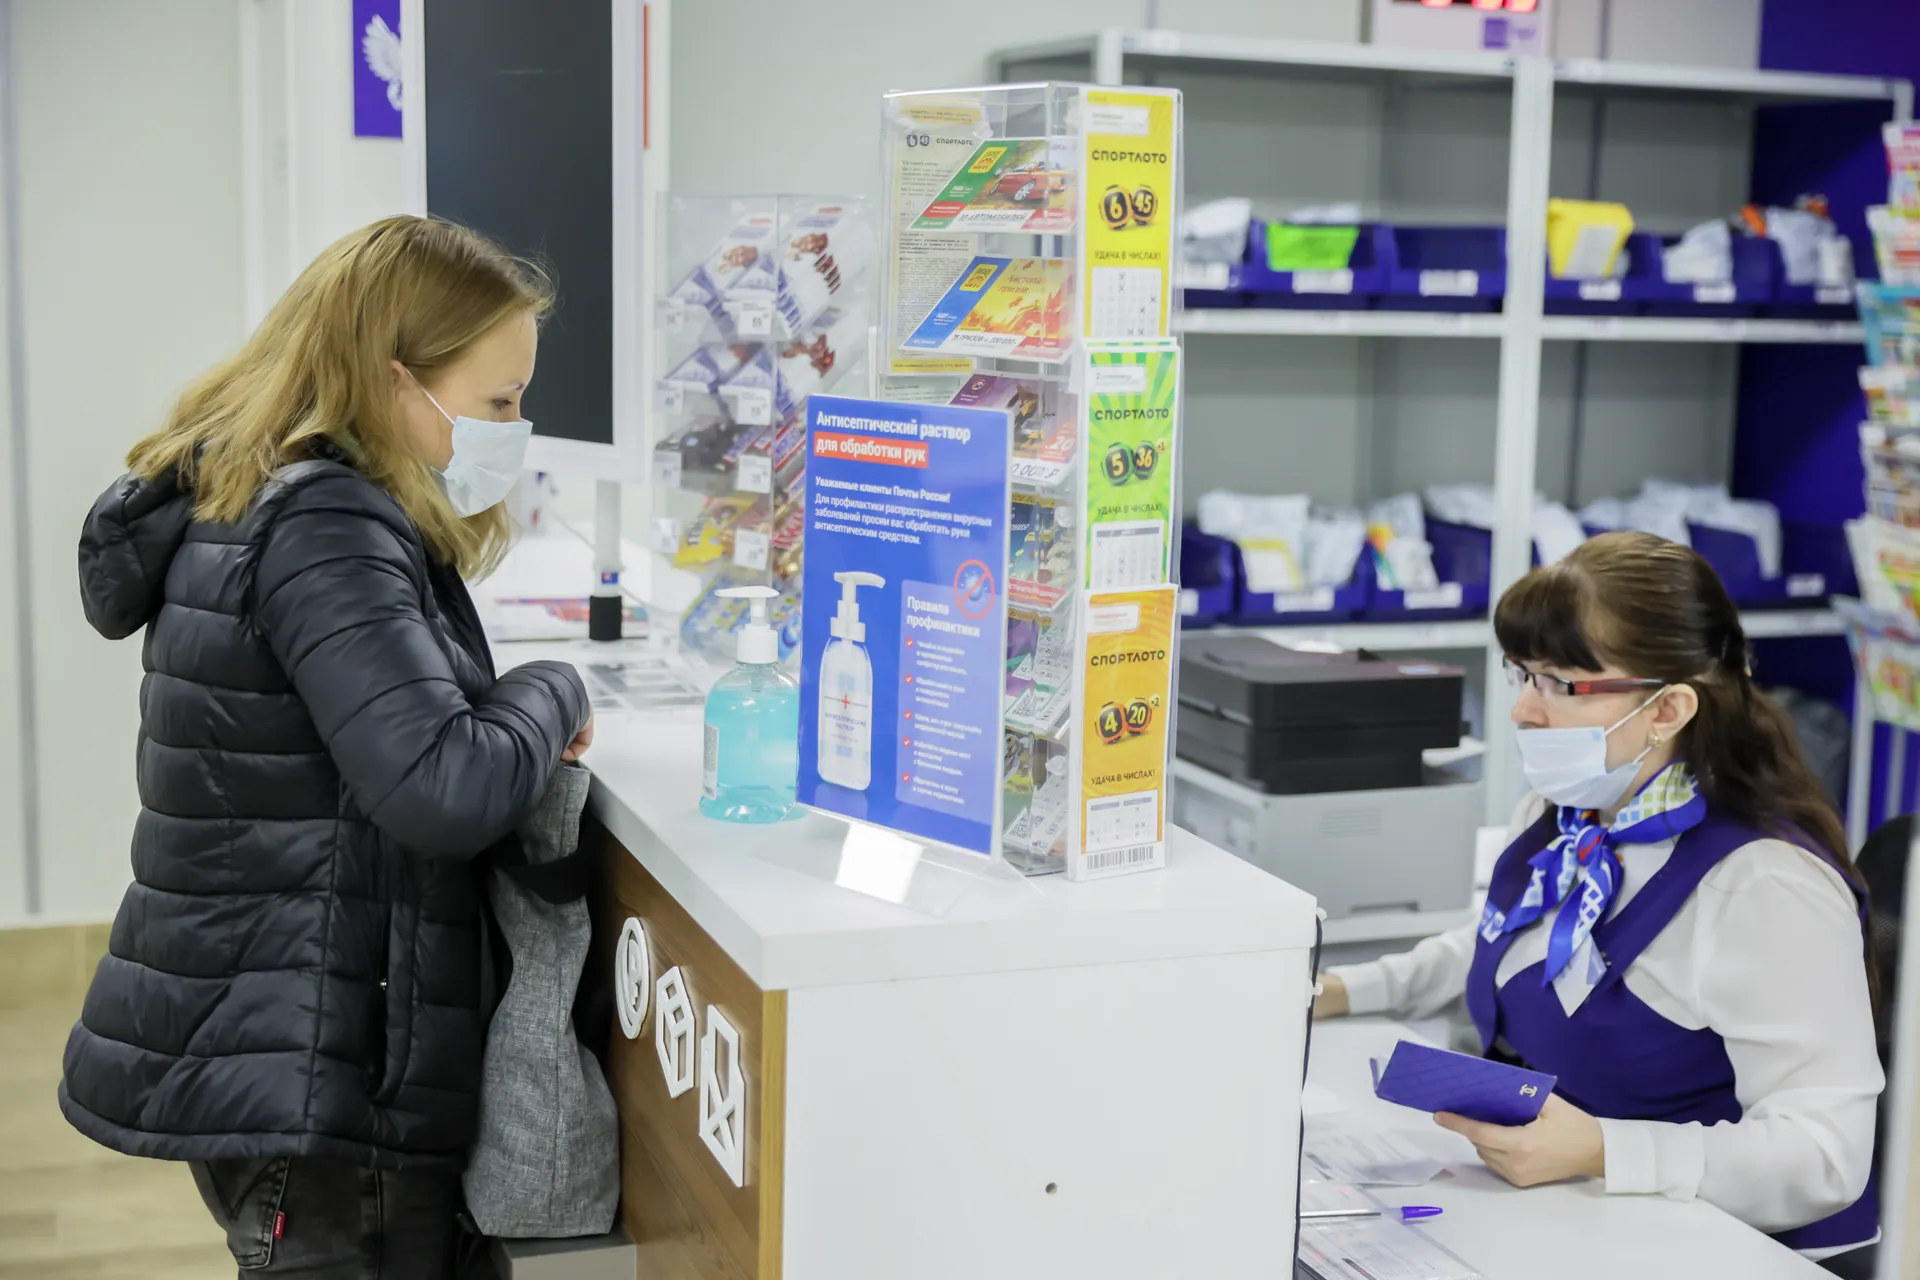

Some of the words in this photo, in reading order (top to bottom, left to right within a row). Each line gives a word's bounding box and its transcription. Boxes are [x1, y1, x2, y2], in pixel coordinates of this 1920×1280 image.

[1092, 149, 1167, 164] СПОРТЛОТО
[1110, 195, 1123, 220] 6
[1135, 192, 1153, 214] 45
[1094, 250, 1120, 260] УДАЧА
[1121, 250, 1127, 260] В
[1128, 251, 1161, 261] ЧИСЛАХ!
[1094, 408, 1169, 421] СПОРТЛОТО
[817, 411, 918, 436] Антисептический
[919, 423, 971, 444] раствор
[816, 438, 838, 454] для
[840, 438, 902, 459] обработки
[903, 447, 927, 464] рук
[1111, 452, 1124, 477] 5
[1136, 447, 1153, 468] 36
[815, 476, 859, 491] Уважаемые
[860, 484, 892, 495] клиенты
[893, 485, 919, 499] Почты
[815, 493, 830, 505] Для
[830, 497, 884, 511] профилактики
[885, 504, 952, 521] распространения
[1097, 505, 1122, 515] УДАЧА
[814, 521, 878, 538] антисептическим
[878, 530, 921, 545] средством.
[815, 507, 861, 522] заболеваний
[861, 514, 890, 526] просим
[890, 519, 904, 528] вас
[905, 520, 950, 535] обработать
[950, 527, 971, 539] руки
[907, 595, 950, 616] Правила
[906, 614, 981, 638] профилактики
[1090, 649, 1165, 667] СПОРТЛОТО
[1104, 711, 1118, 733] 4
[1128, 705, 1147, 725] 20
[1091, 775, 1116, 786] УДАЧА
[1116, 773, 1122, 782] В
[1123, 769, 1156, 780] ЧИСЛАХ!
